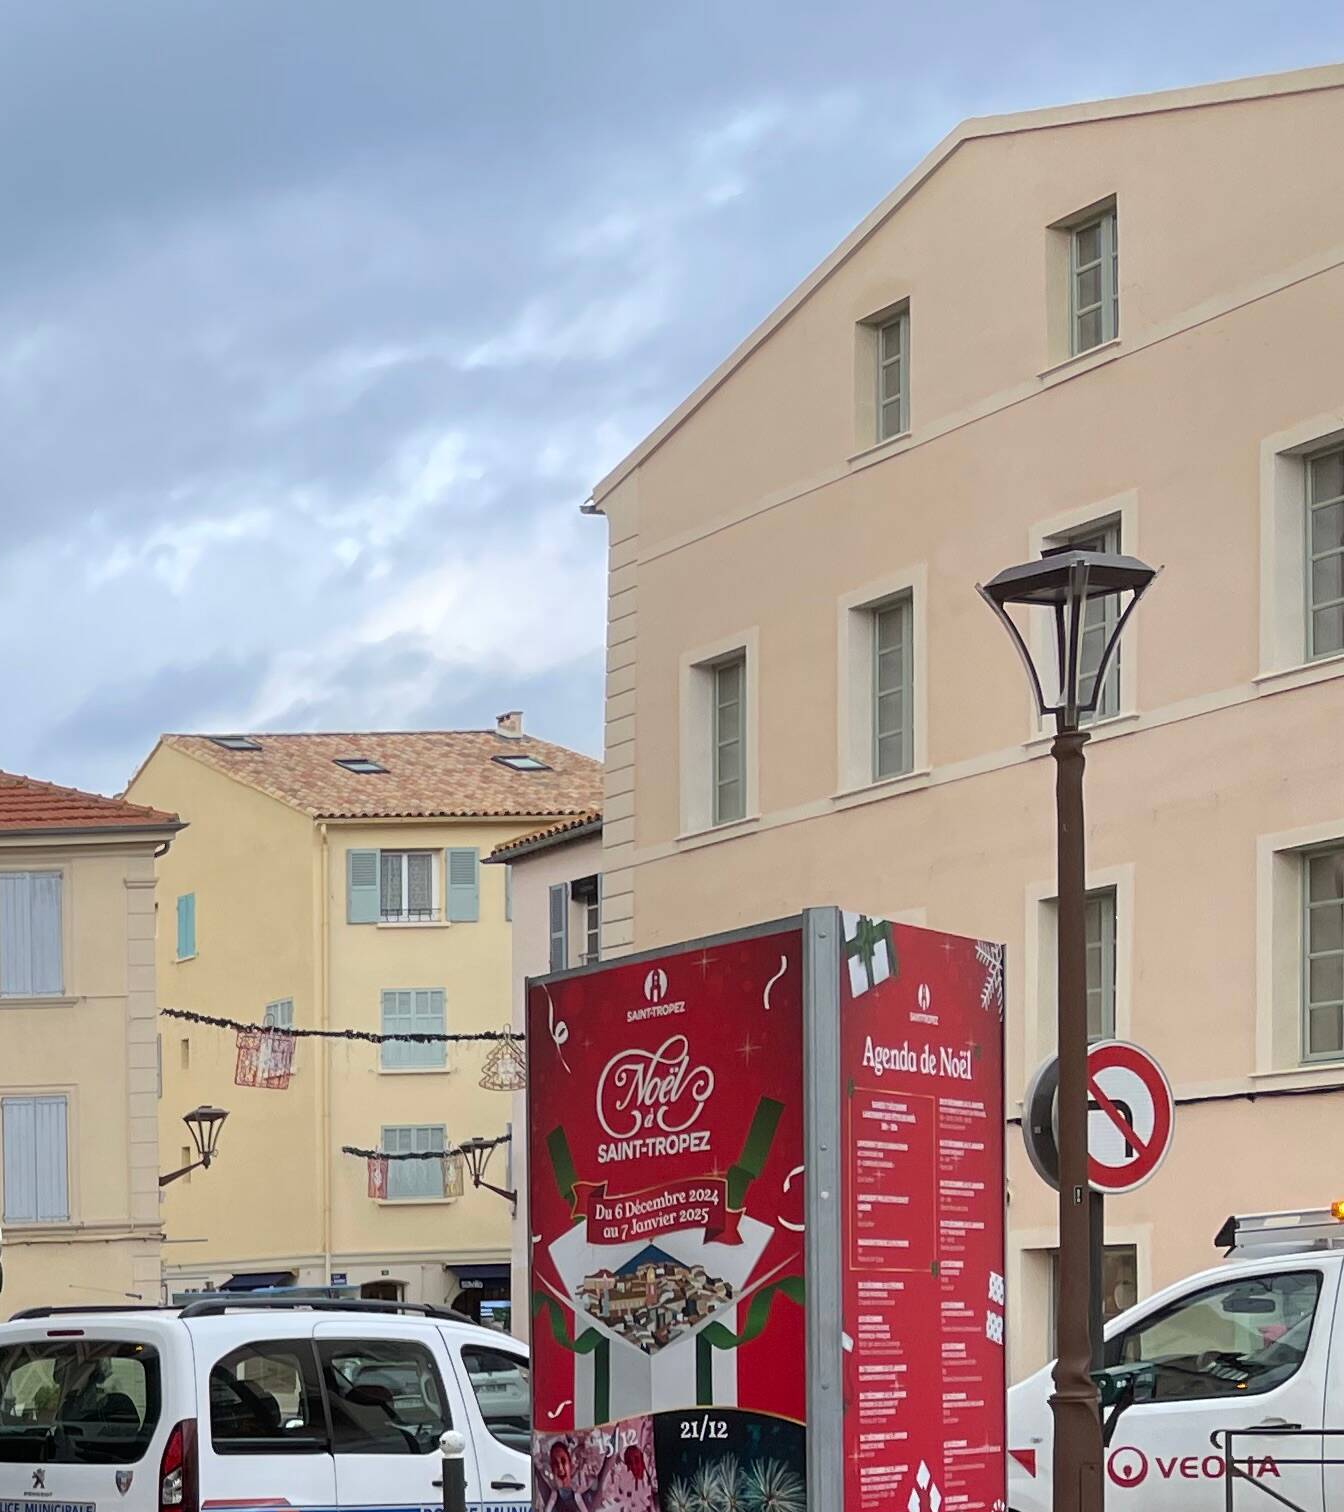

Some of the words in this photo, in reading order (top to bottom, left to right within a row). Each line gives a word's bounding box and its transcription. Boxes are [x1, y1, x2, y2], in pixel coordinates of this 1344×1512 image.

[626, 1001, 686, 1023] SAINT-TROPEZ
[861, 1035, 917, 1076] Agenda
[920, 1043, 937, 1075] de
[939, 1046, 972, 1080] Noël
[597, 1130, 711, 1164] SAINT-TROPEZ
[595, 1204, 613, 1220] Du
[615, 1203, 623, 1219] 6
[625, 1191, 686, 1218] Décembre
[688, 1189, 719, 1206] 2024
[603, 1226, 619, 1239] au
[621, 1224, 629, 1240] 7
[630, 1211, 677, 1235] Janvier
[679, 1207, 710, 1224] 2025
[679, 1414, 729, 1442] 21/12
